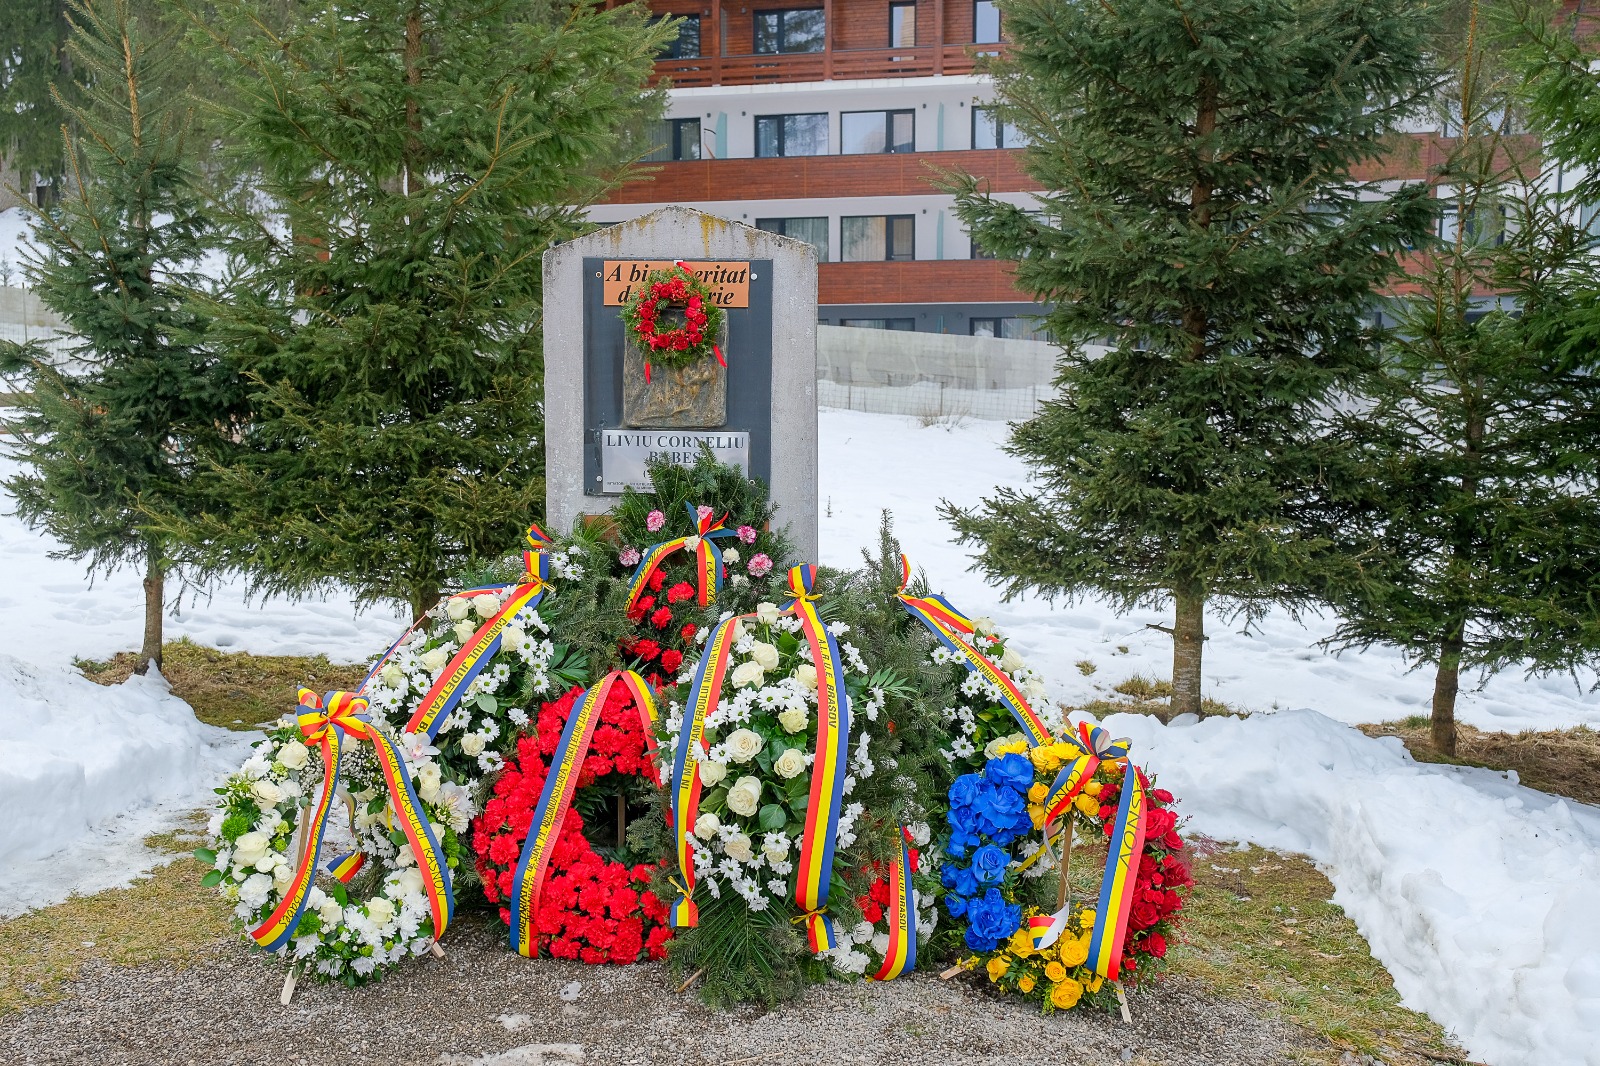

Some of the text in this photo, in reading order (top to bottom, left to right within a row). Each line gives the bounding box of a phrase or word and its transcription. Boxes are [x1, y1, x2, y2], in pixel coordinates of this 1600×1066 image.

[606, 264, 622, 281] A
[606, 435, 744, 449] LIVIU CORNELIU
[648, 451, 702, 464] BBES
[467, 617, 508, 662] CONSILIUL
[425, 661, 469, 719] JUDETEAN
[966, 652, 1015, 702] LIVIU-CORNELIU
[680, 778, 689, 789] IN
[694, 684, 709, 721] EROULUI
[704, 653, 717, 683] MARTIR
[825, 683, 836, 727] BRASOV
[1013, 700, 1036, 730] MARTIR
[394, 779, 429, 840] ORASULUI
[422, 845, 447, 896] RASNOV
[898, 894, 906, 930] BRASOV
